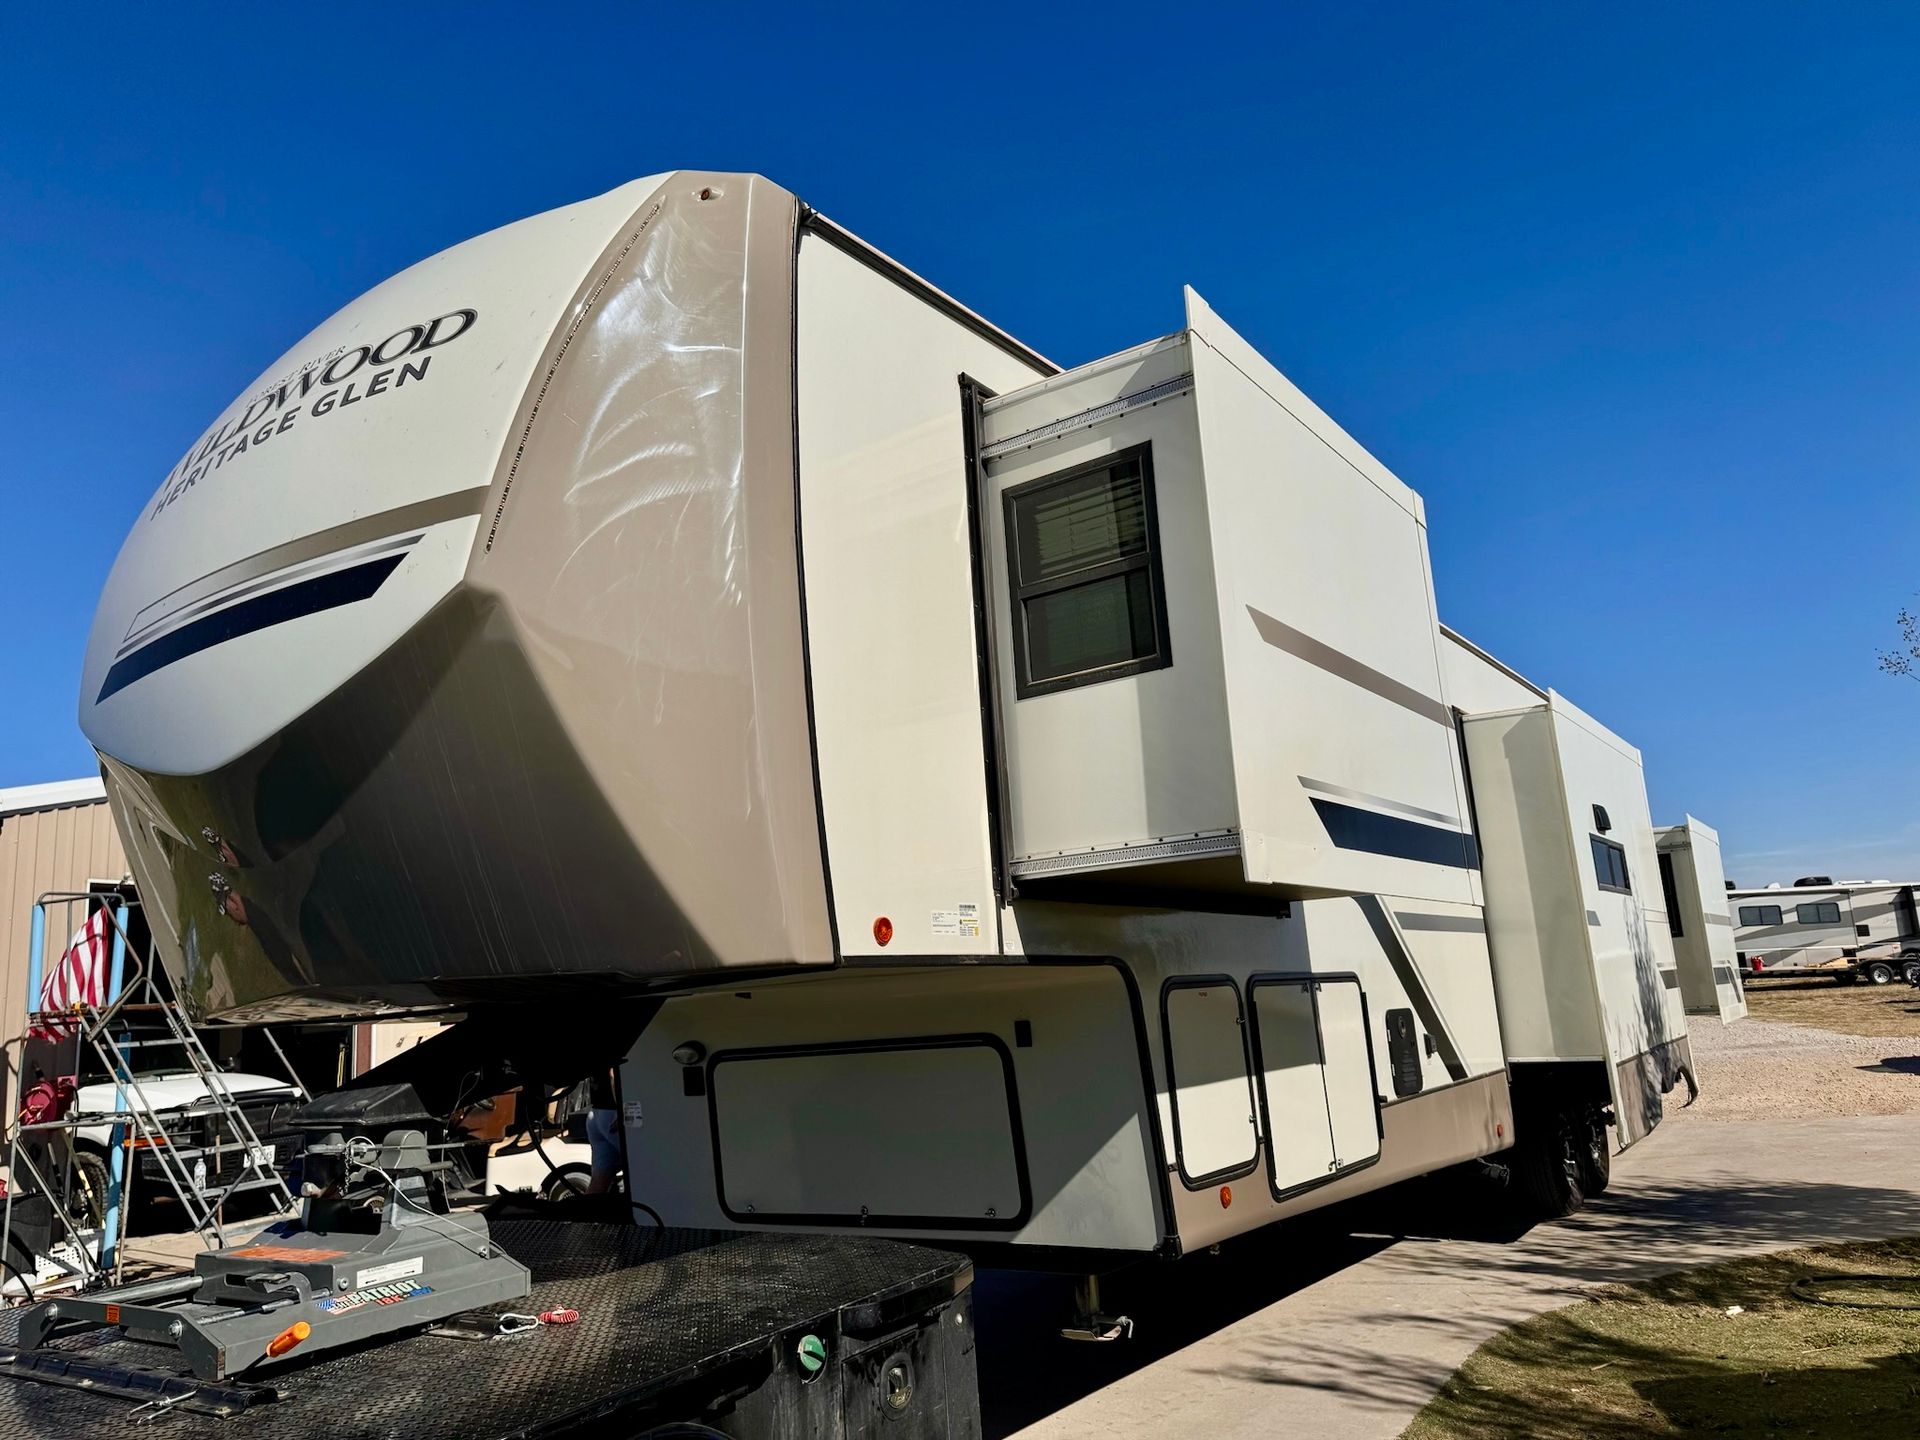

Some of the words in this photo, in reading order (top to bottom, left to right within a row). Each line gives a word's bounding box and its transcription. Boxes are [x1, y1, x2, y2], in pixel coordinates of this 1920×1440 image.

[298, 345, 346, 375] RIVER
[163, 308, 478, 492] WILDWOOD
[150, 405, 301, 521] HERITAGE
[311, 356, 432, 418] GLEN
[346, 1279, 422, 1305] PATRIOT
[375, 1295, 404, 1307] 18K
